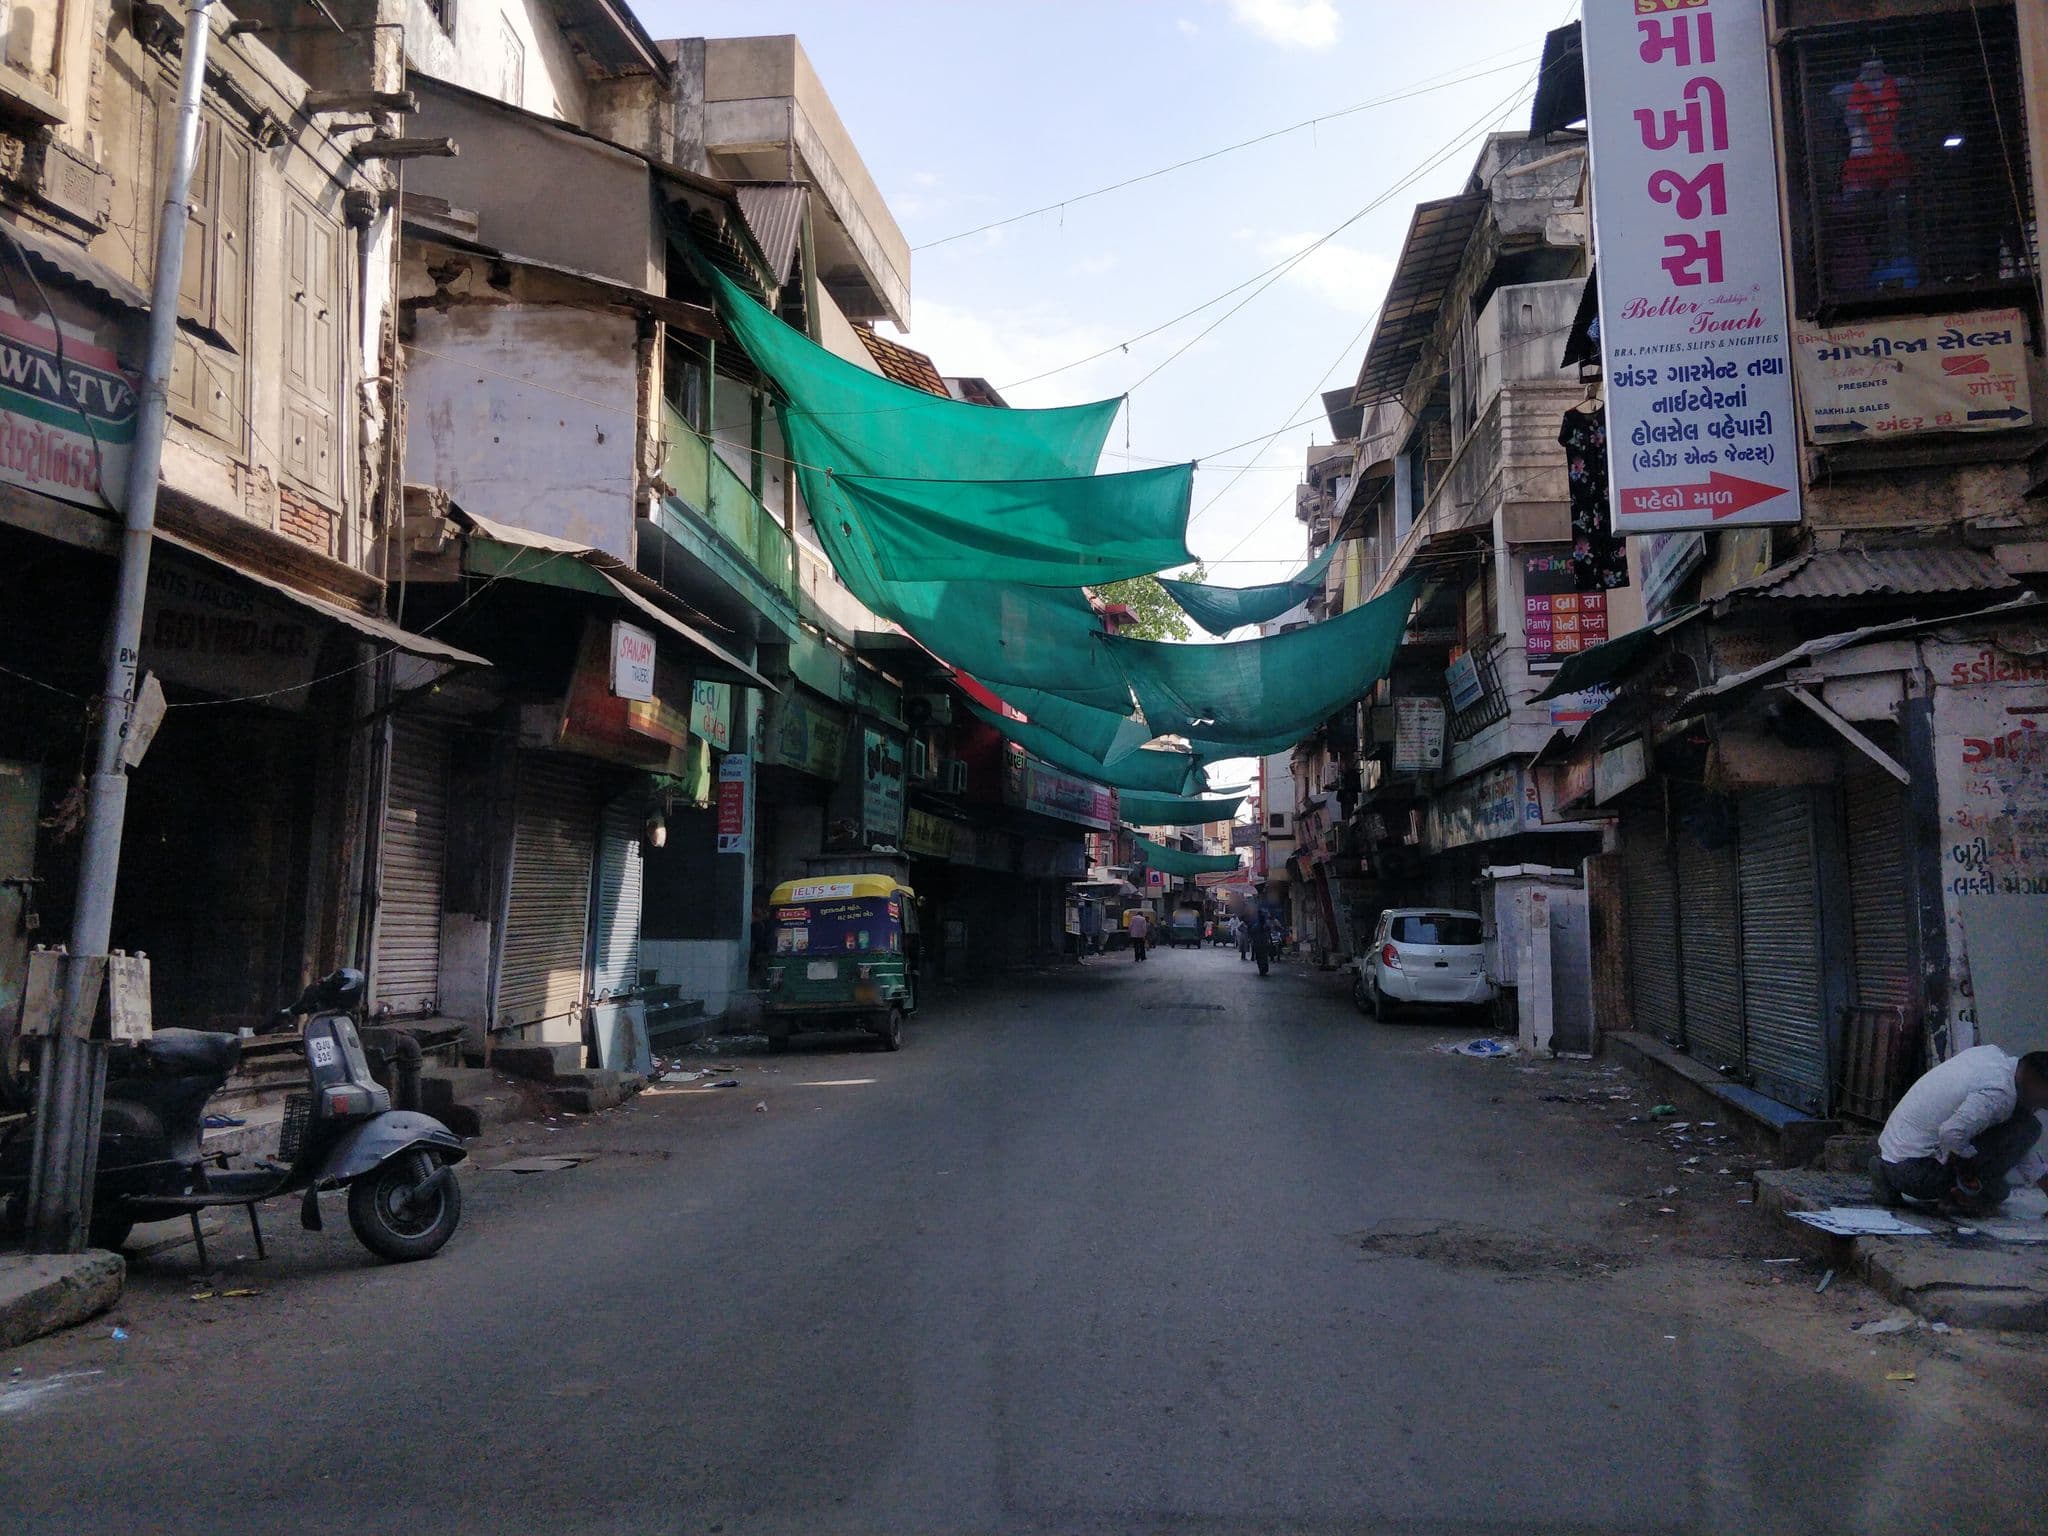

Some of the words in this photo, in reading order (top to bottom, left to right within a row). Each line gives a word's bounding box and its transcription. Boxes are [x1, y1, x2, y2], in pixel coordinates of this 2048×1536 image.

[1621, 296, 1701, 321] Better
[1689, 308, 1767, 335] Touch
[1614, 347, 1637, 358] BRA,
[1640, 343, 1685, 356] PANTIES,
[1687, 340, 1716, 351] SLIPS
[1718, 338, 1725, 349] &
[1727, 334, 1779, 348] NIGHTIES
[1817, 337, 1927, 361] માખીજા
[1936, 328, 2012, 351] સેલ્સ
[1614, 364, 1658, 388] અંડર
[1667, 356, 1738, 383] ગારમેન્ટ
[1747, 357, 1784, 377] તથા
[1837, 378, 1888, 391] PRESENTS
[1815, 407, 1857, 416] MAKHIJA
[1858, 402, 1891, 413] SALES
[1631, 418, 1698, 446] હોલસેલ
[1707, 411, 1773, 439] વહેપારી
[1633, 488, 1684, 510] પહેલો
[1694, 490, 1734, 507] માળ
[1527, 598, 1549, 612] Bra
[1526, 618, 1551, 632] Panty
[620, 635, 652, 663] SANJAY
[1528, 637, 1551, 650] Slip
[794, 885, 825, 896] IELTS
